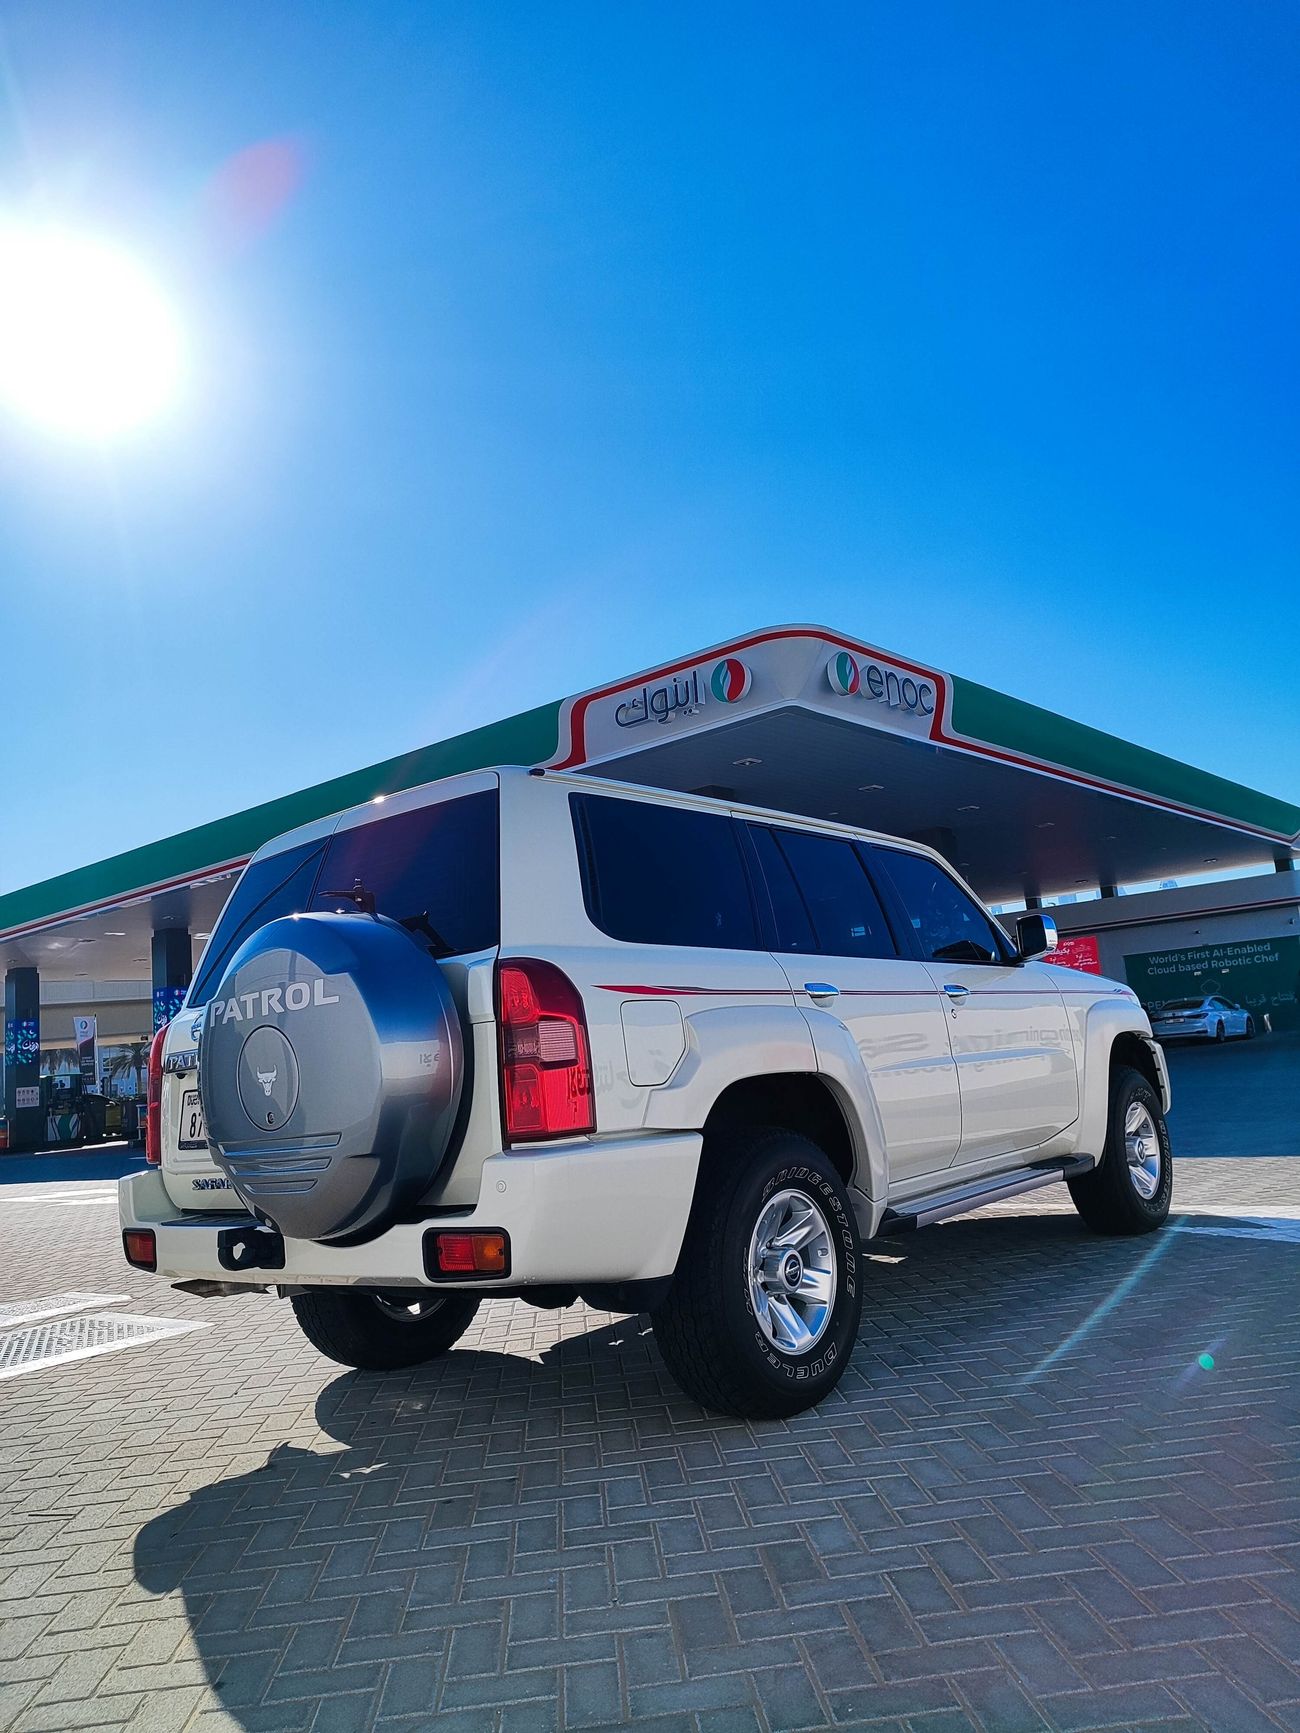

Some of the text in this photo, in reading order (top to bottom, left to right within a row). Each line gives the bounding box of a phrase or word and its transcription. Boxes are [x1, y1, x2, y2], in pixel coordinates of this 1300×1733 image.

[615, 670, 699, 727] اينوك
[866, 664, 934, 715] enoc
[1147, 952, 1280, 976] Cloud based Robotic Chef
[1148, 943, 1271, 965] World's First AI-Enabled
[210, 978, 340, 1028] PATROL
[762, 1166, 856, 1298] BRIDGESTONE
[755, 1331, 838, 1380] DUELER
